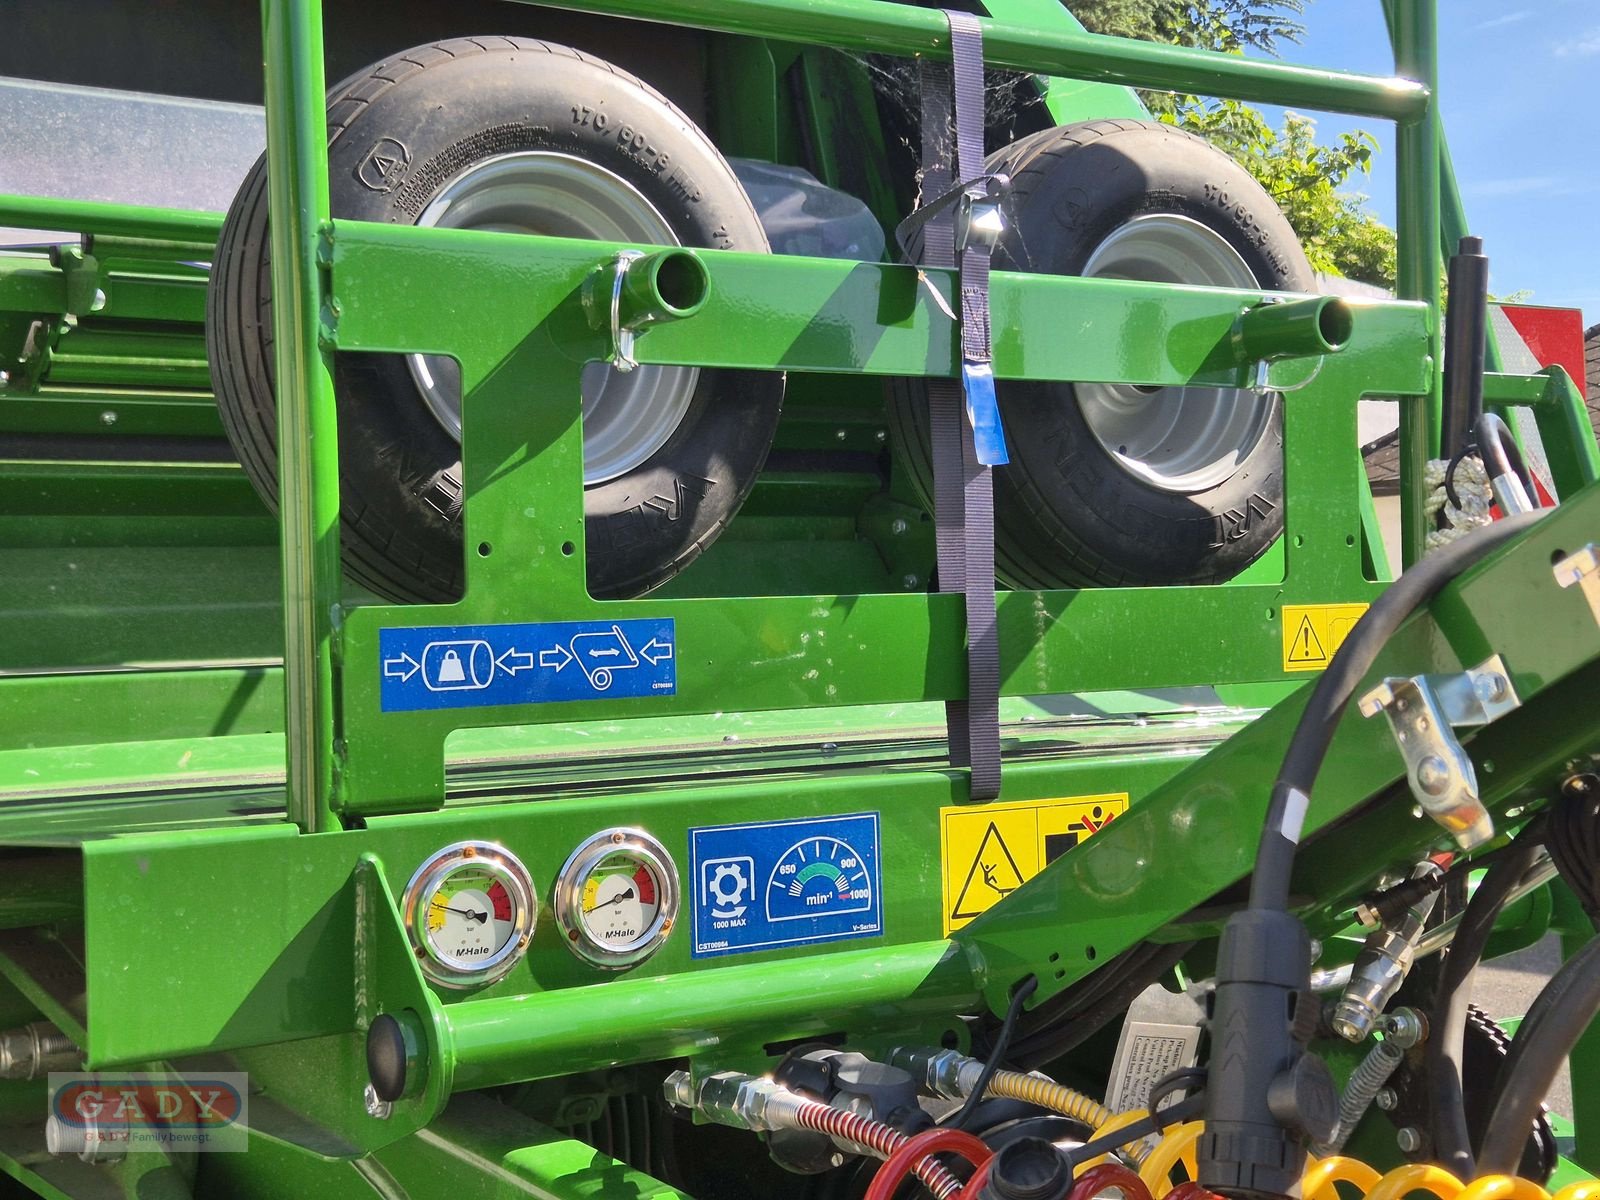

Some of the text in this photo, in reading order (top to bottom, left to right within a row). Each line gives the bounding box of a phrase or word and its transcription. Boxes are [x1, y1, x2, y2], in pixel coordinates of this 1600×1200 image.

[840, 858, 857, 869] 900
[779, 864, 796, 875] 650
[849, 889, 869, 899] 1000
[712, 918, 747, 929] 1000 MAX
